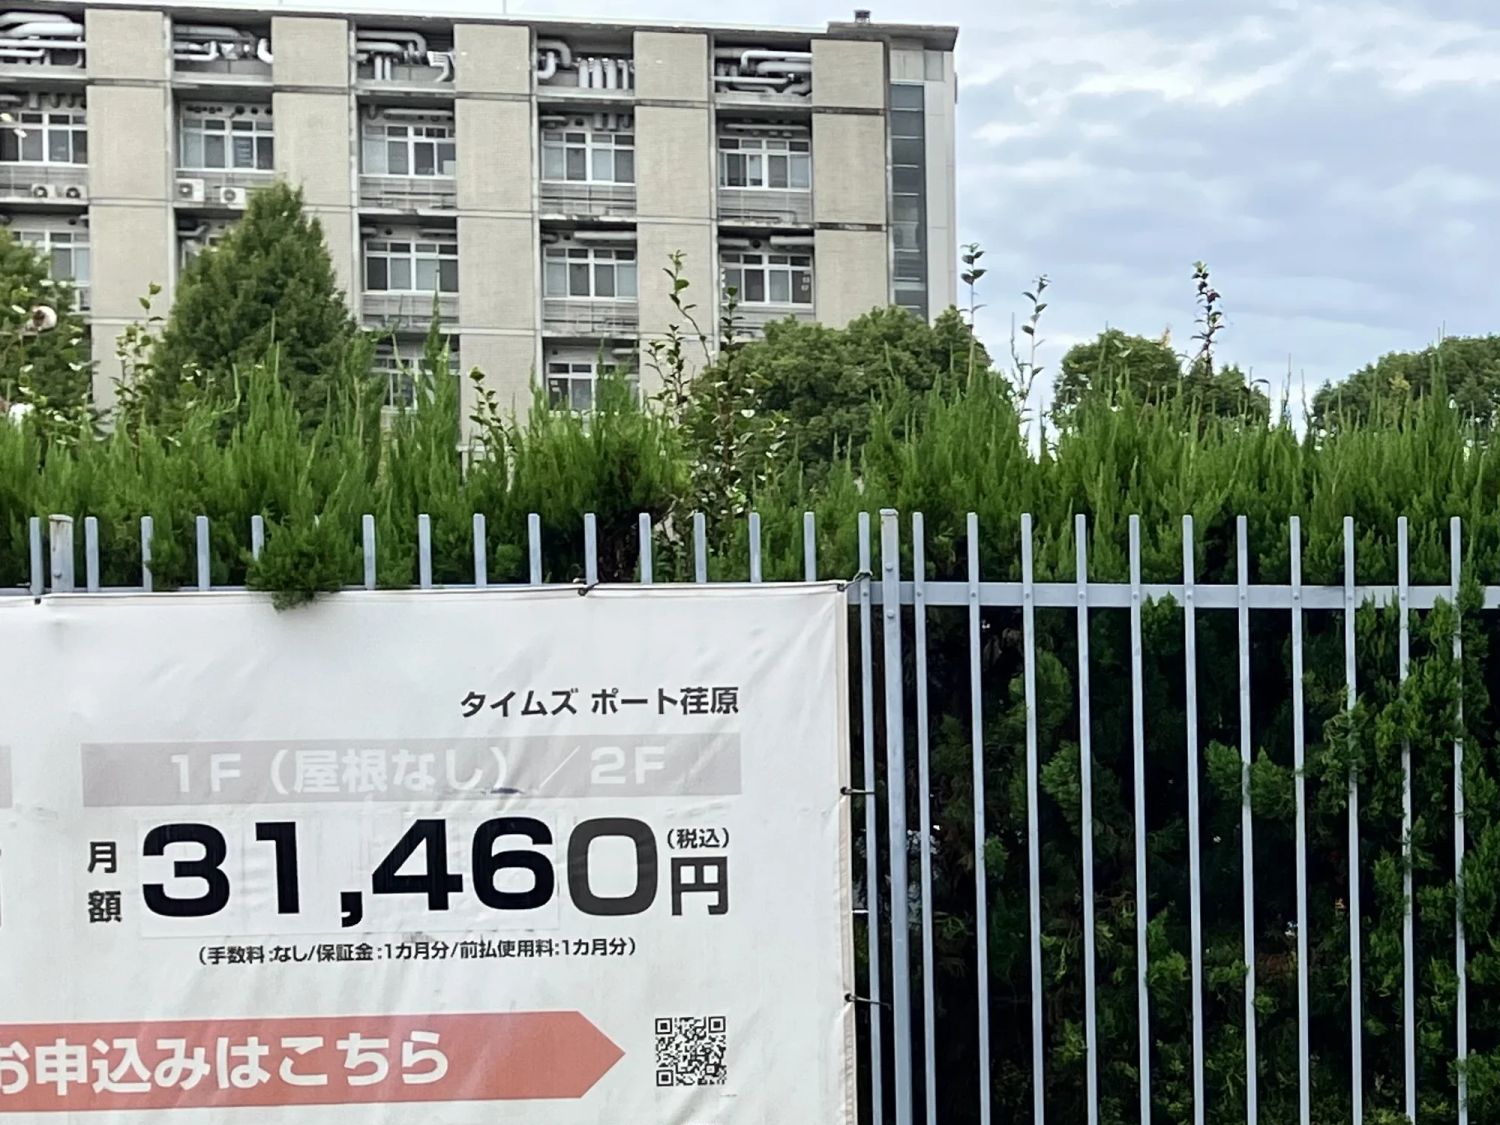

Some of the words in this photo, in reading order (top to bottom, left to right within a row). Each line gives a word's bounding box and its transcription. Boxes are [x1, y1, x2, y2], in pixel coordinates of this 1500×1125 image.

[460, 688, 579, 717] タイムズ
[591, 686, 740, 715] ポート荏原
